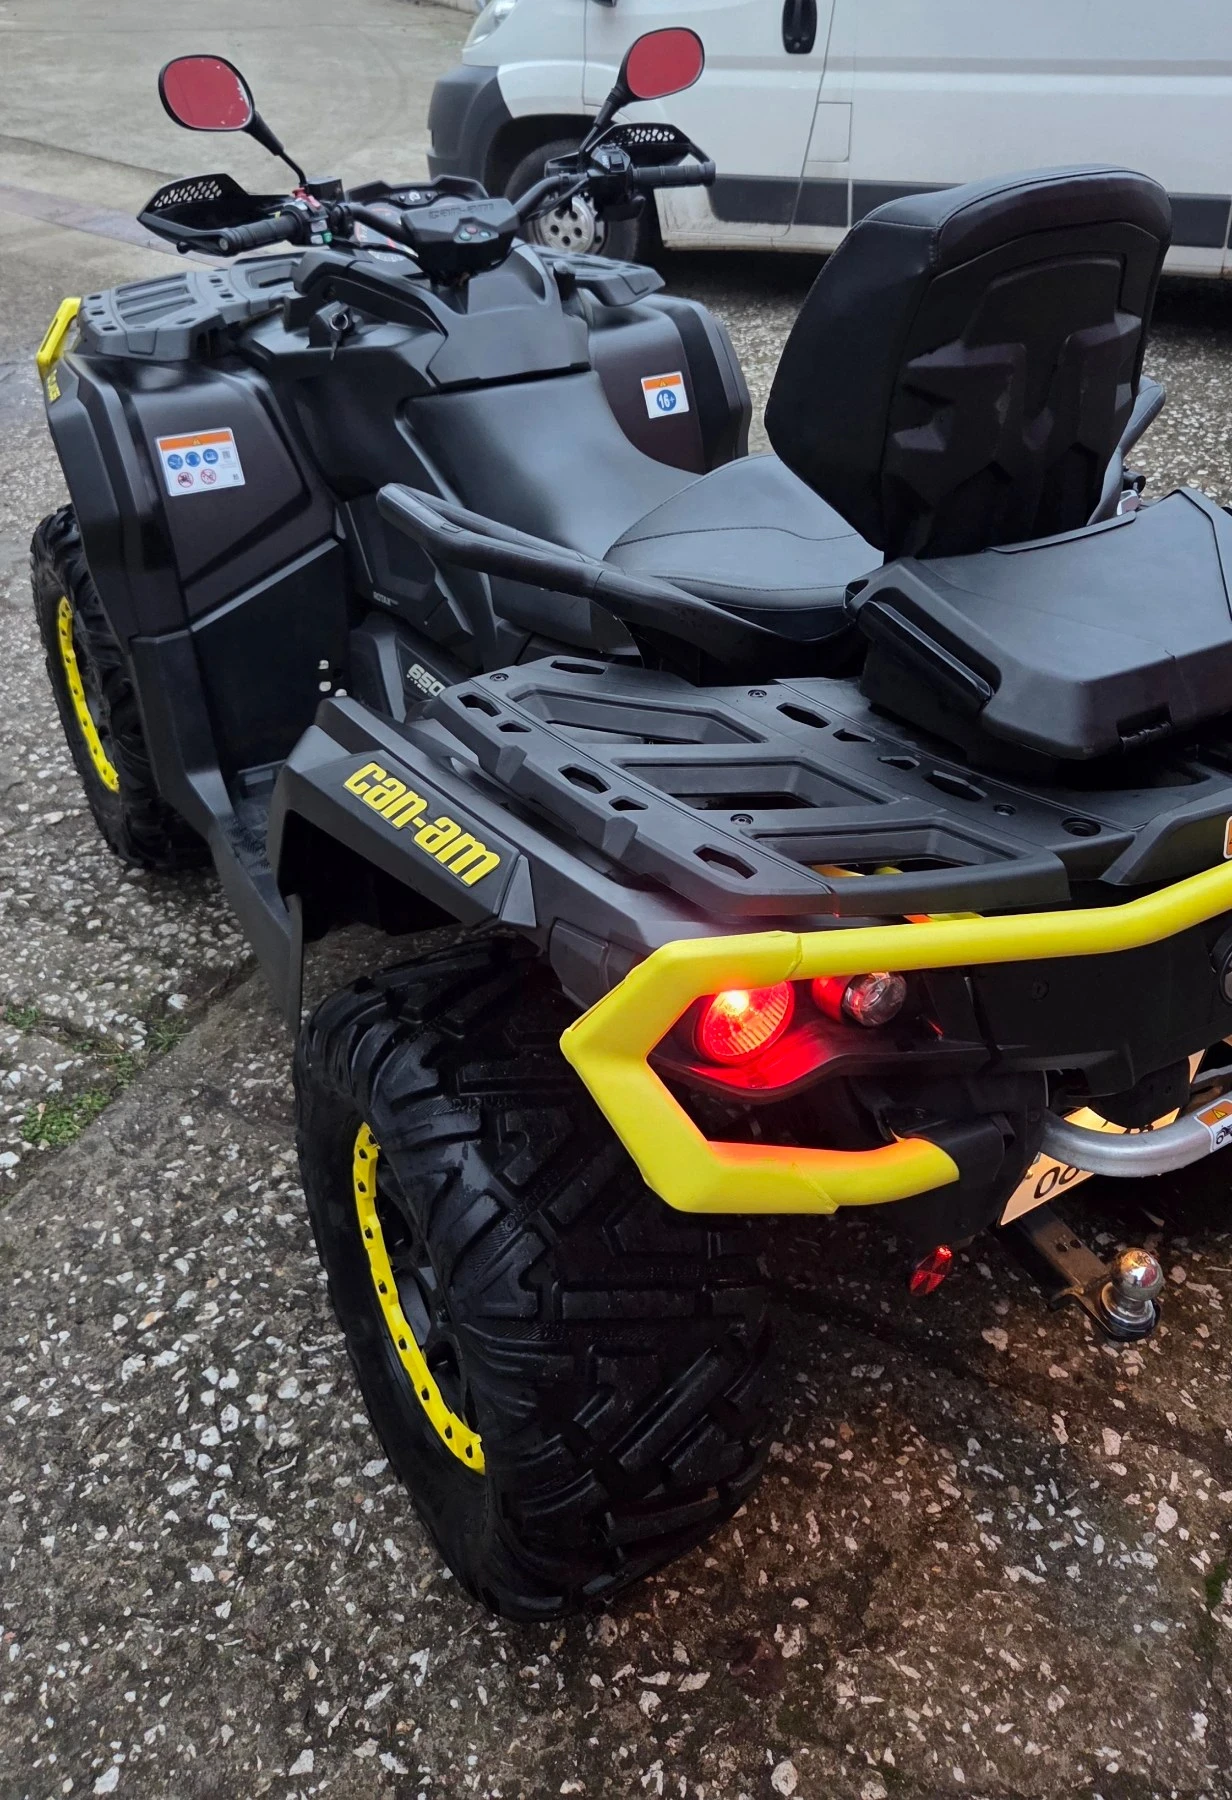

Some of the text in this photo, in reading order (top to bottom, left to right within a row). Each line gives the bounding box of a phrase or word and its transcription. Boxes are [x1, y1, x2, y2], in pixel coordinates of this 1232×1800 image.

[658, 393, 675, 409] 16+
[408, 663, 446, 697] 650
[343, 762, 500, 887] can-am
